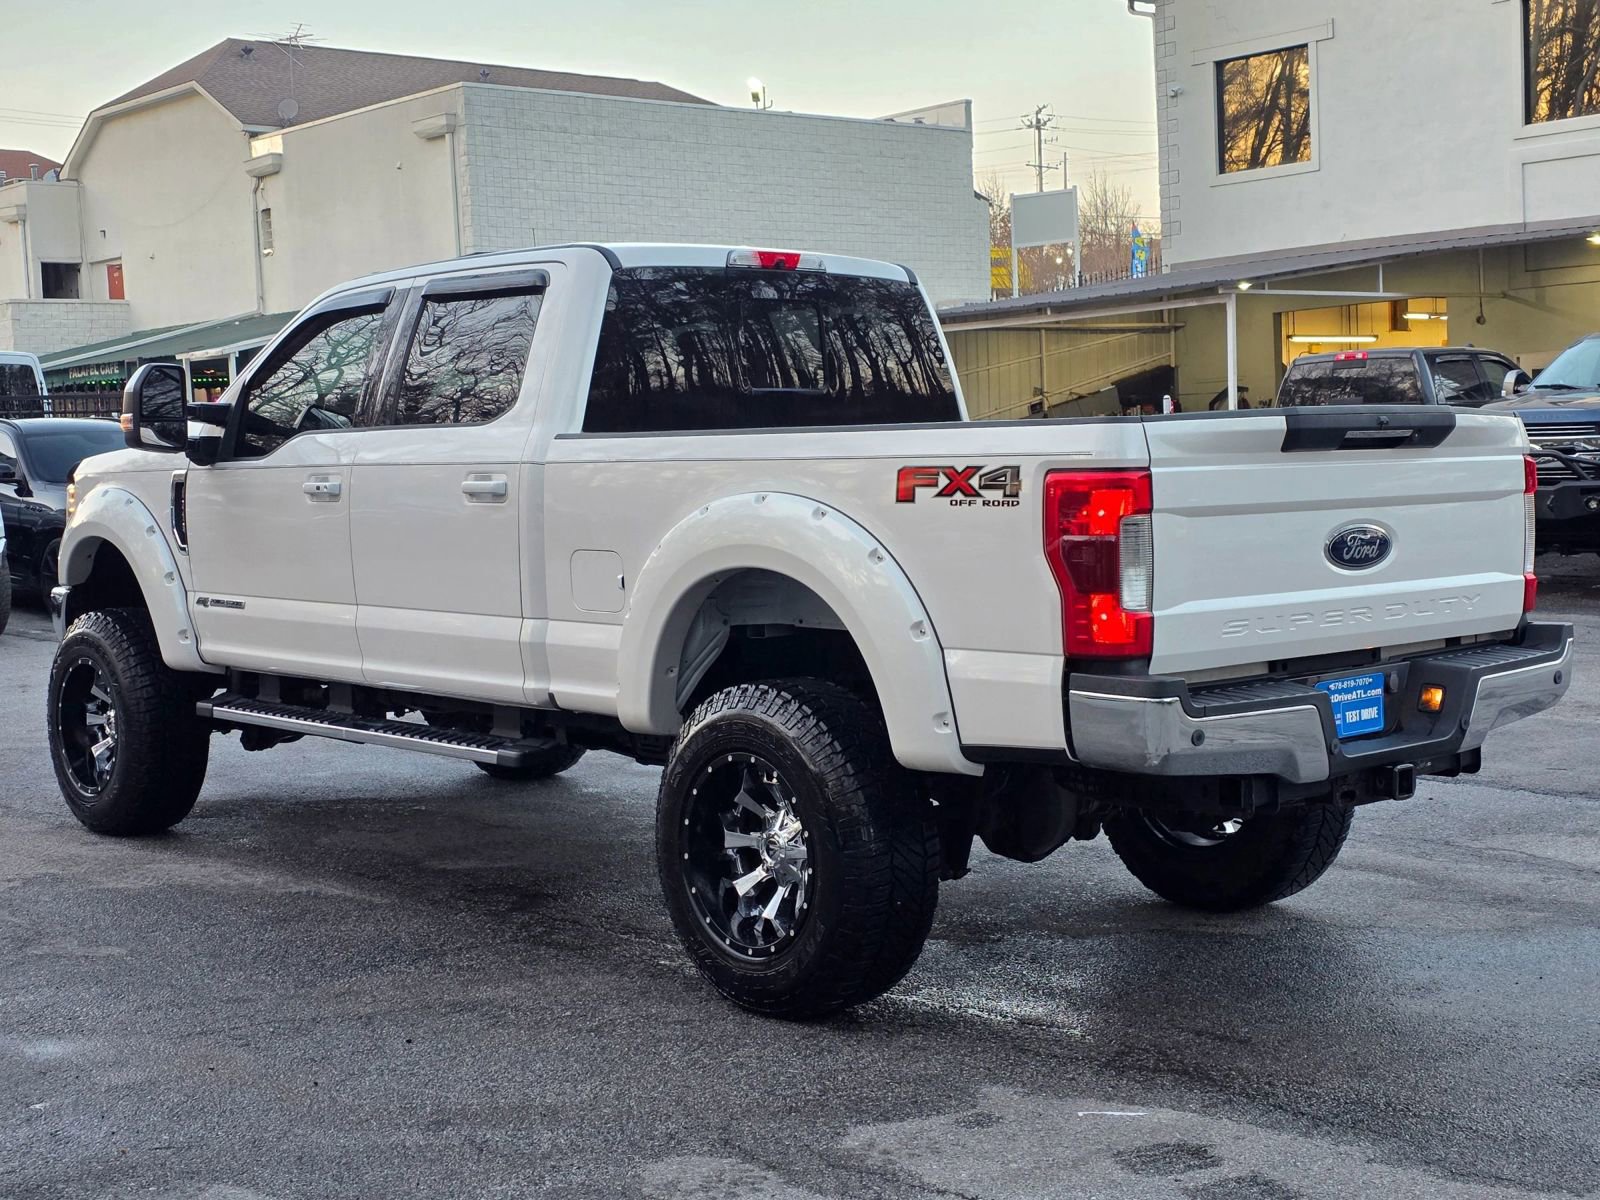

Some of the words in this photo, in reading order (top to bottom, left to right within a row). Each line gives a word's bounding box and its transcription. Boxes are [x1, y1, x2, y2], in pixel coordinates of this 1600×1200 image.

[69, 364, 99, 379] FALAFEL
[100, 364, 119, 375] CAFE
[896, 465, 1021, 503] FX4
[949, 499, 978, 508] OFF
[982, 499, 1020, 508] ROAD
[1343, 533, 1381, 561] Ford
[1221, 606, 1373, 638] SUPER
[1384, 593, 1481, 620] DUTY
[1330, 688, 1382, 702] tDriveATL.com
[1345, 709, 1360, 723] TEST
[1360, 706, 1378, 720] DRIVE
